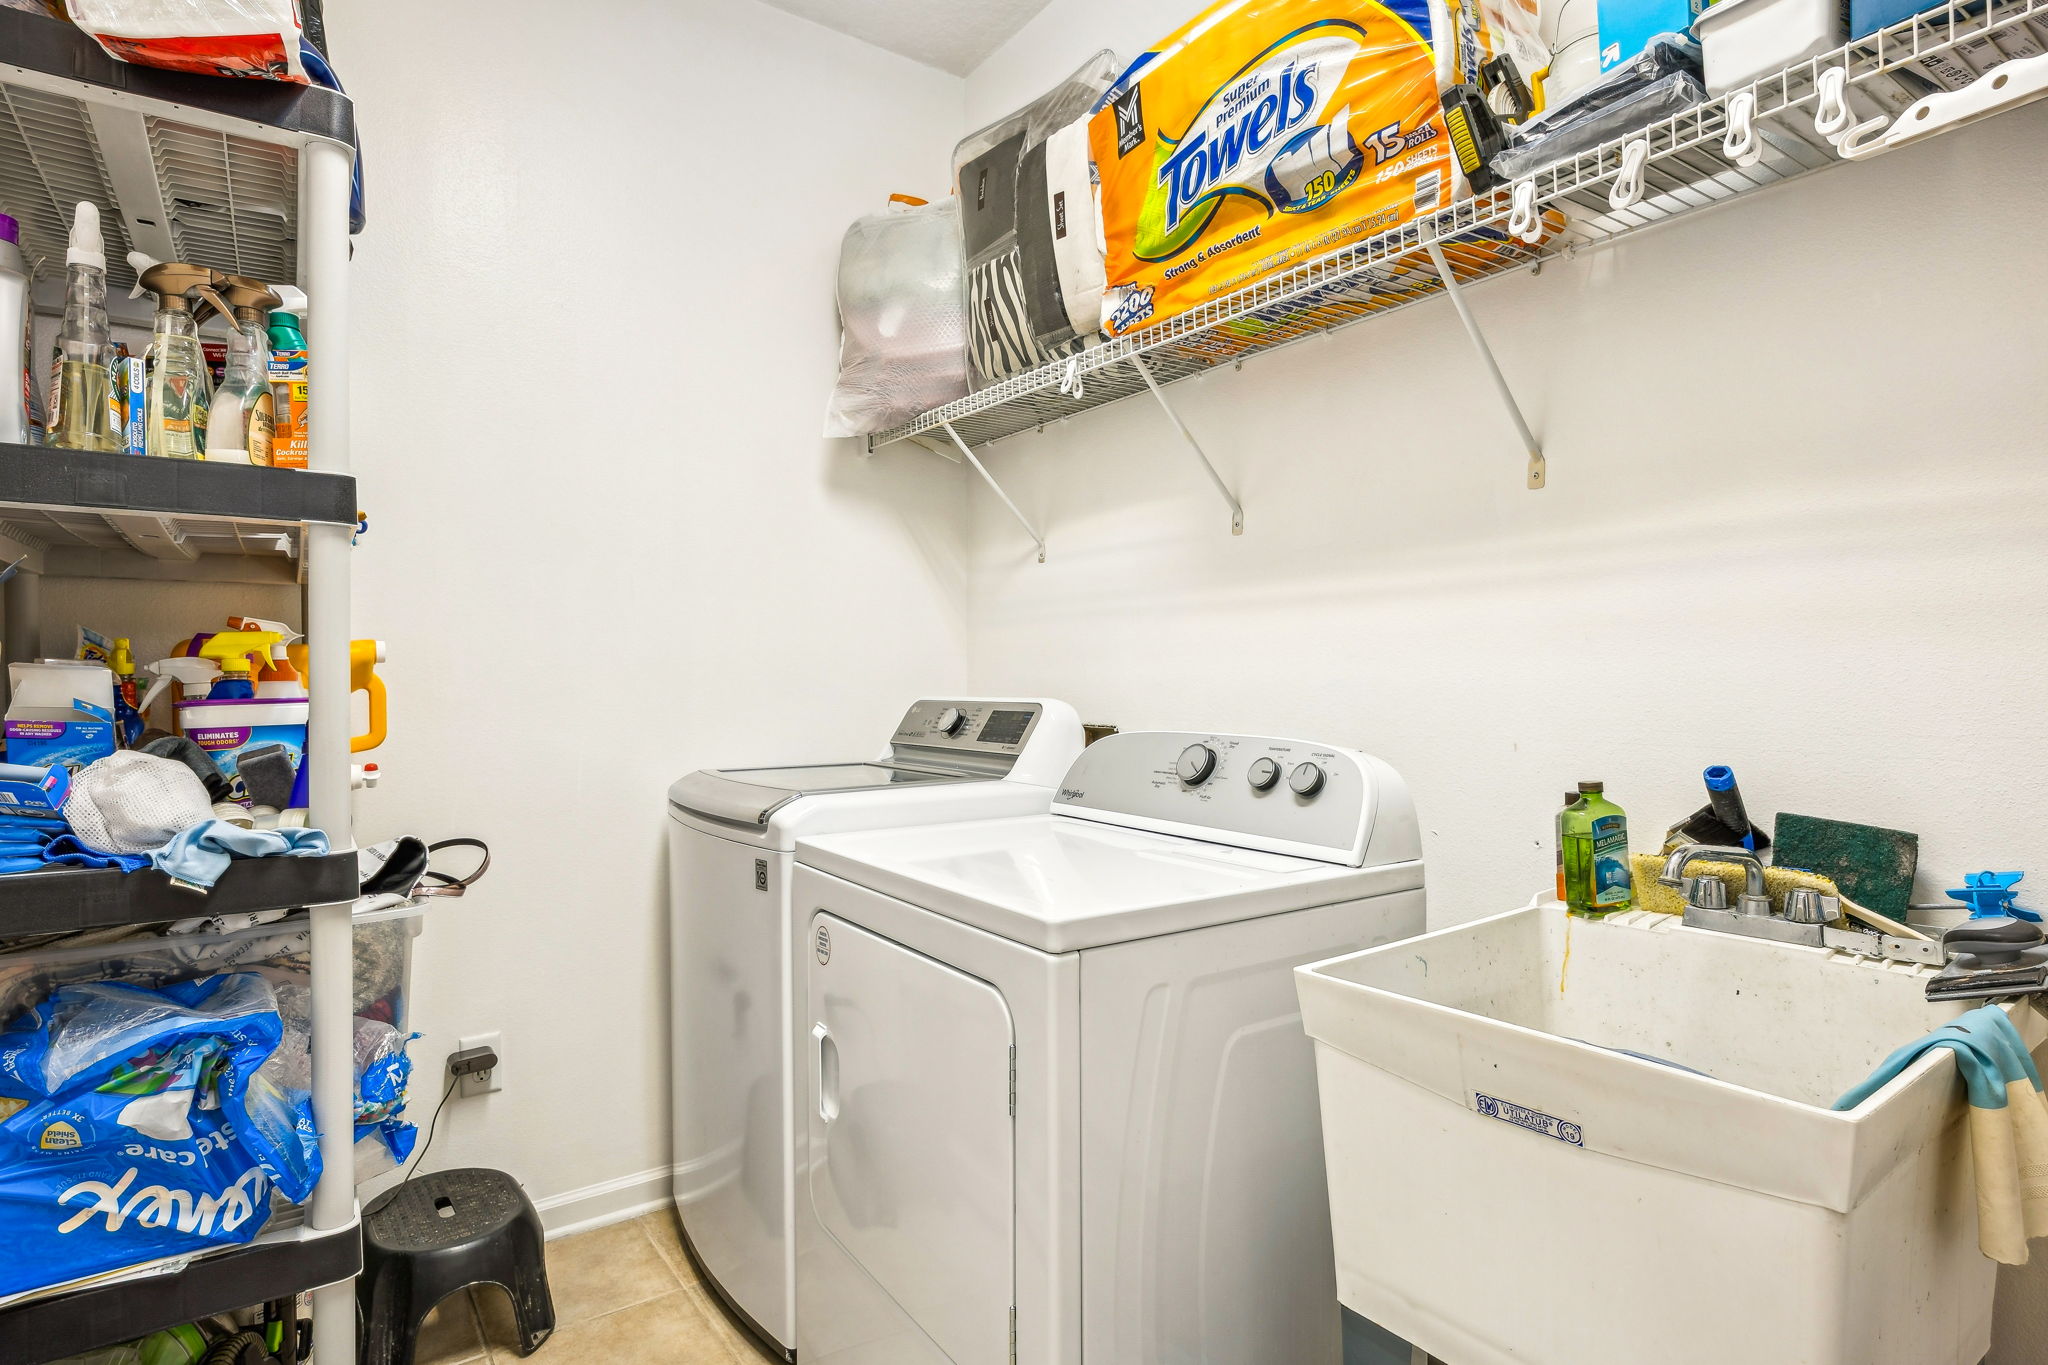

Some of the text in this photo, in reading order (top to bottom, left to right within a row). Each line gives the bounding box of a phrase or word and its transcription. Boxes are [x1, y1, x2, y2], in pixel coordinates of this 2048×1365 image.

[1223, 72, 1260, 108] Super
[1216, 78, 1270, 128] Premium
[1158, 60, 1319, 233] Towels
[1364, 121, 1405, 166] 15
[1407, 129, 1438, 149] ROLLS
[1406, 143, 1438, 165] SHEETS
[1304, 170, 1336, 201] 150
[1163, 224, 1262, 281] Strong & Absorbent
[1111, 285, 1154, 328] 2200
[269, 362, 290, 370] TERRO
[197, 731, 239, 740] ELIMINATES
[1596, 832, 1627, 848] MELAMAGIC
[71, 1112, 85, 1123] 3X
[45, 1137, 78, 1146] Clean
[47, 1130, 76, 1138] Shield
[1565, 1131, 1575, 1141] 19
